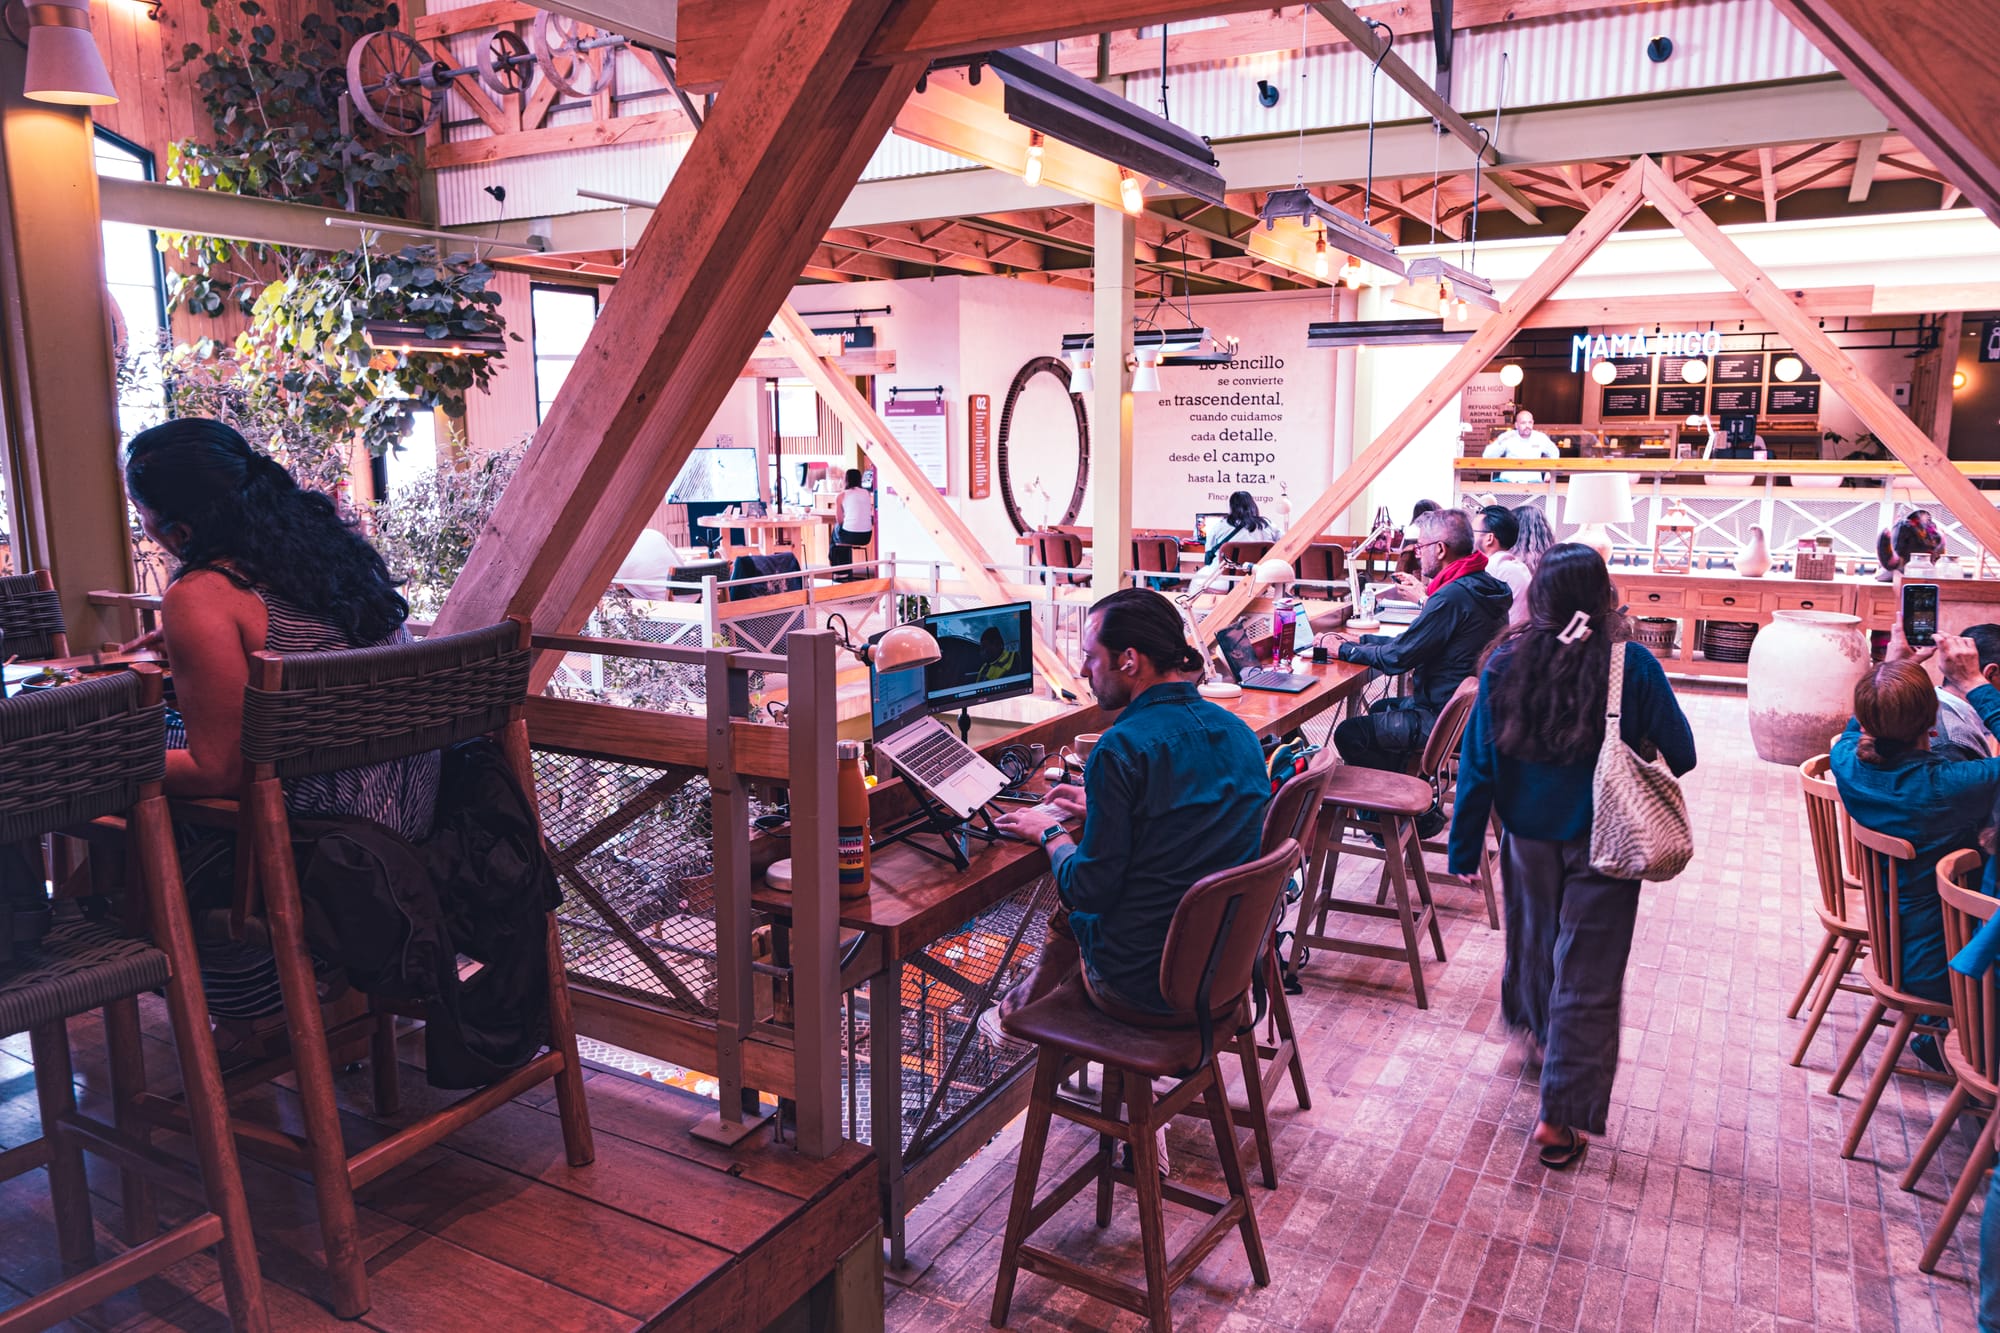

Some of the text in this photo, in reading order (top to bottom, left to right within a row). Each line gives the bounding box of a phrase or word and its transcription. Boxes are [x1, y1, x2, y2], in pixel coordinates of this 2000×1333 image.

[1571, 328, 1647, 372] MAMÁ
[1656, 331, 1720, 356] HIGO
[1222, 355, 1284, 370] sencillo
[1217, 376, 1284, 386] se convierte
[976, 397, 986, 410] 02
[1189, 412, 1283, 422] cuando cuidamos
[1191, 432, 1216, 441] cada
[1169, 449, 1275, 466] desde el campo
[1188, 473, 1214, 483] hasta
[1217, 470, 1231, 483] la
